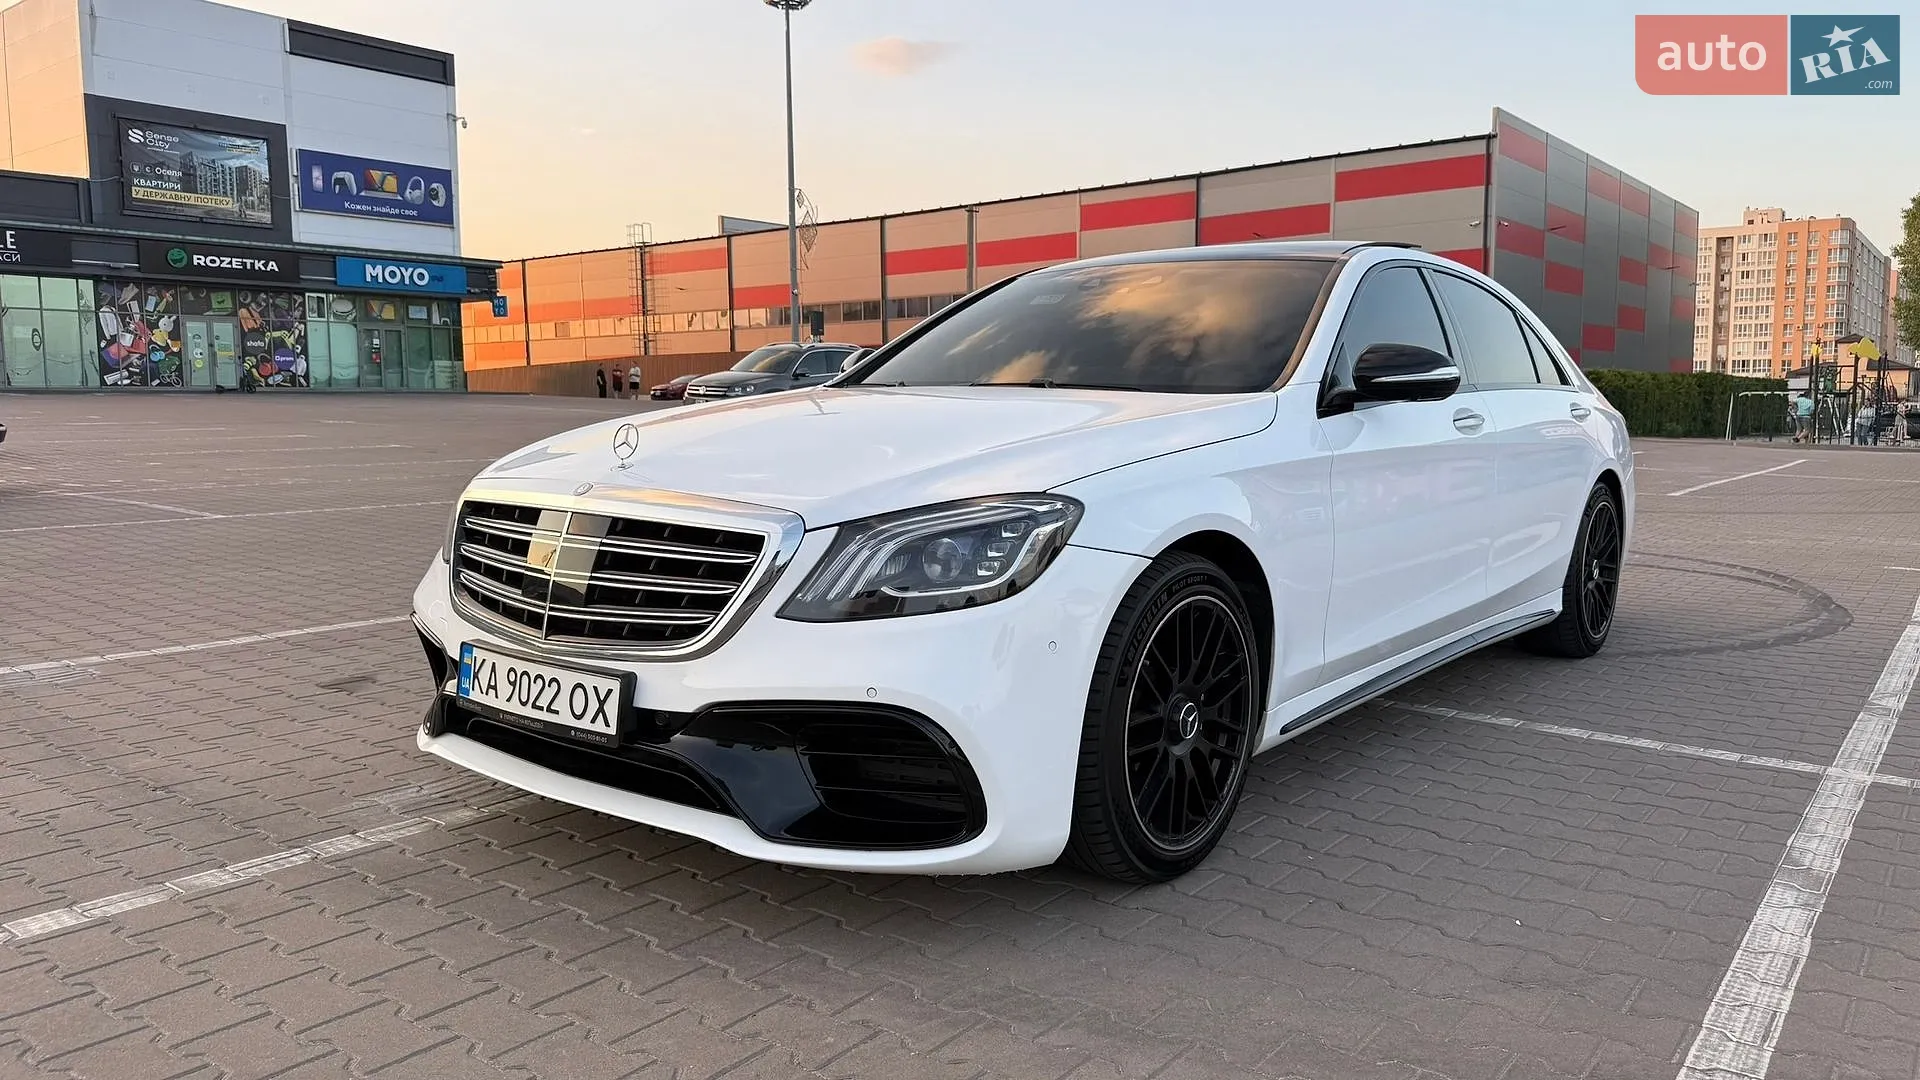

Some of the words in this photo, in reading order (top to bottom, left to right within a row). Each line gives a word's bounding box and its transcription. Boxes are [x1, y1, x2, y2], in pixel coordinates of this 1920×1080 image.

[146, 139, 170, 149] City
[155, 167, 183, 177] Оселя
[133, 178, 181, 190] КВАРТИРИ
[142, 189, 192, 202] ДЕРЖАВНУ
[193, 196, 230, 206] ІПОТЕКУ
[344, 201, 371, 211] Кожен
[373, 206, 400, 214] знайде
[0, 231, 16, 249] E
[192, 254, 279, 272] ROZETKA
[365, 264, 430, 286] MOYO
[1127, 591, 1168, 662] MICHELIN
[461, 677, 470, 690] UA
[472, 655, 499, 699] KA
[505, 667, 562, 716] 9022
[569, 682, 614, 728] OX
